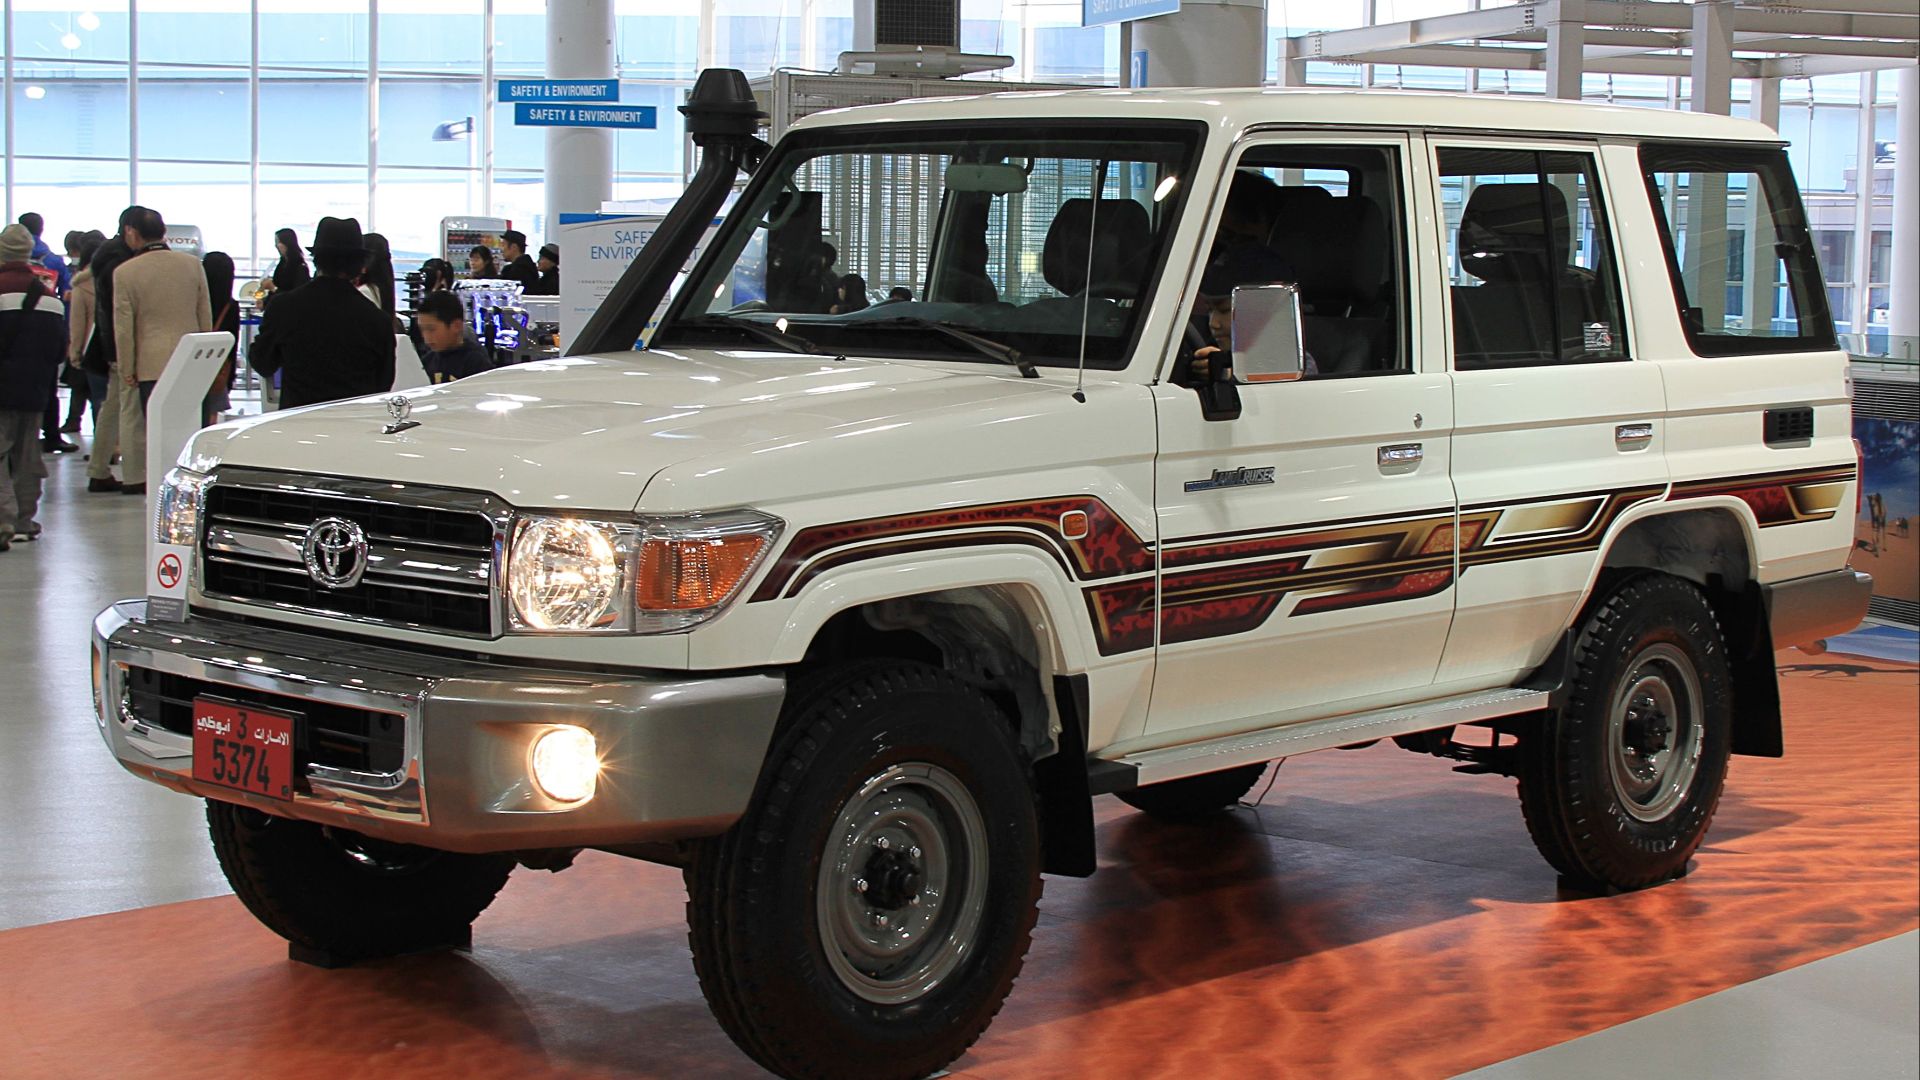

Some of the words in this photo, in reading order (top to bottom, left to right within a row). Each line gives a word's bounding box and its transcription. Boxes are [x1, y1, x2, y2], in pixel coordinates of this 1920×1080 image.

[511, 85, 542, 97] SAFETY
[544, 86, 550, 97] &
[552, 85, 607, 97] ENVIRONMENT
[530, 109, 566, 121] SAFETY
[570, 110, 576, 121] &
[579, 111, 642, 123] ENVIRONMENT
[164, 237, 198, 246] YOTA
[615, 230, 655, 244] SAFE
[237, 711, 247, 740] 3
[254, 728, 289, 746] الامارات
[213, 739, 270, 792] 5374
